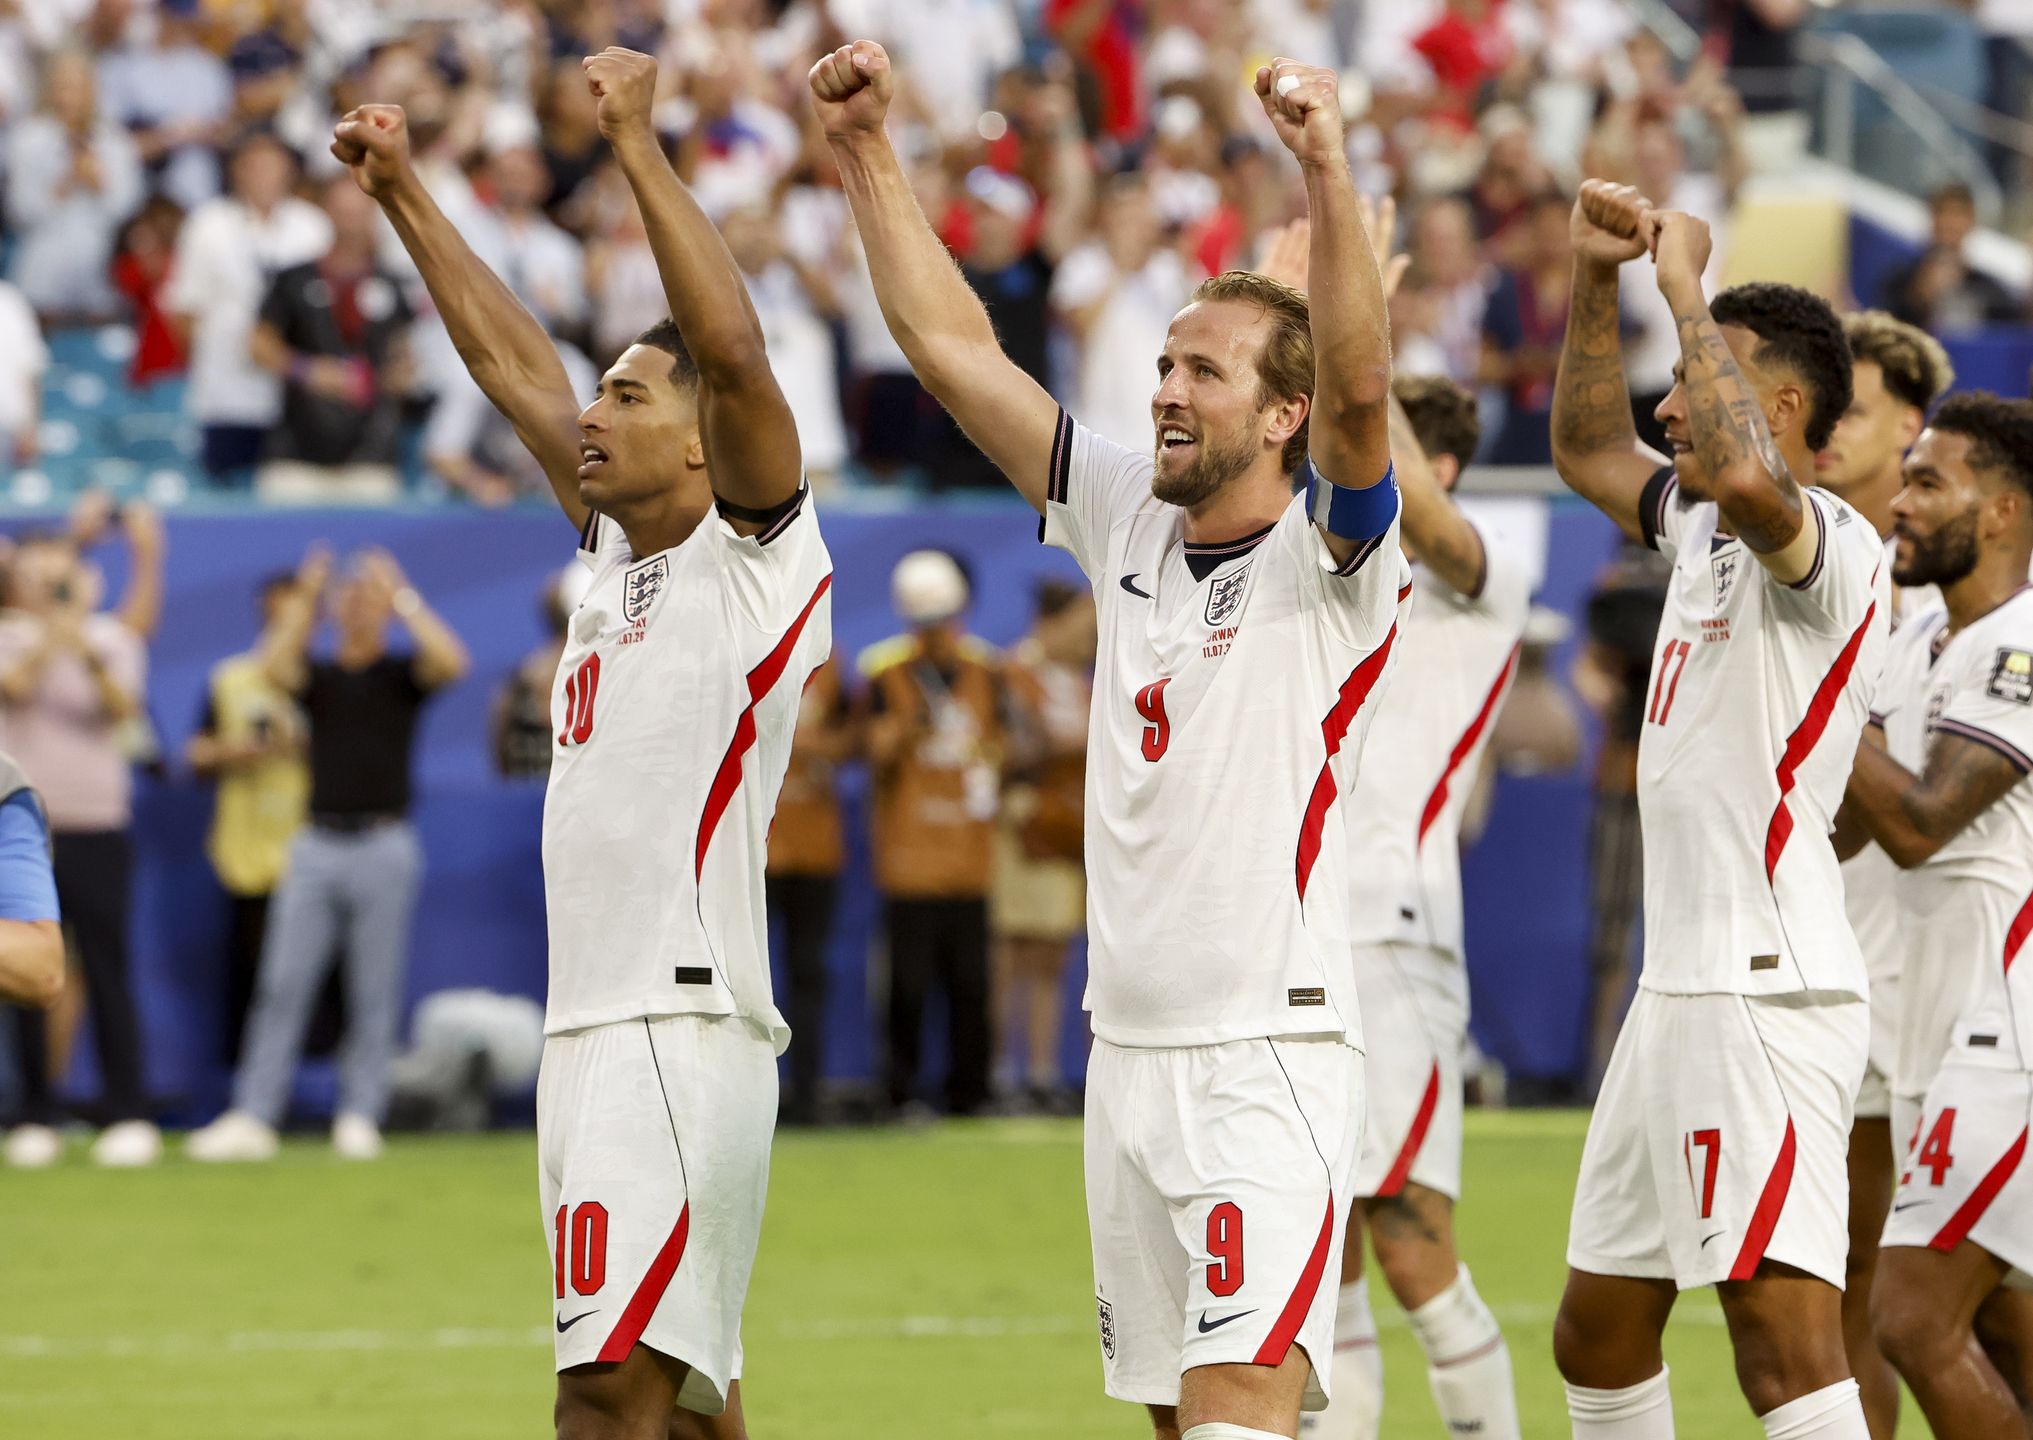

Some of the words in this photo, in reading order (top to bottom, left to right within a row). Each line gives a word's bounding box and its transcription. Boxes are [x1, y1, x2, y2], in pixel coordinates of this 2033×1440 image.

[558, 651, 601, 746] 10
[1135, 678, 1172, 763] 9
[1648, 638, 1691, 727] 17
[1684, 1128, 1721, 1219] 7
[555, 1201, 608, 1299] 10
[1206, 1201, 1244, 1297] 9
